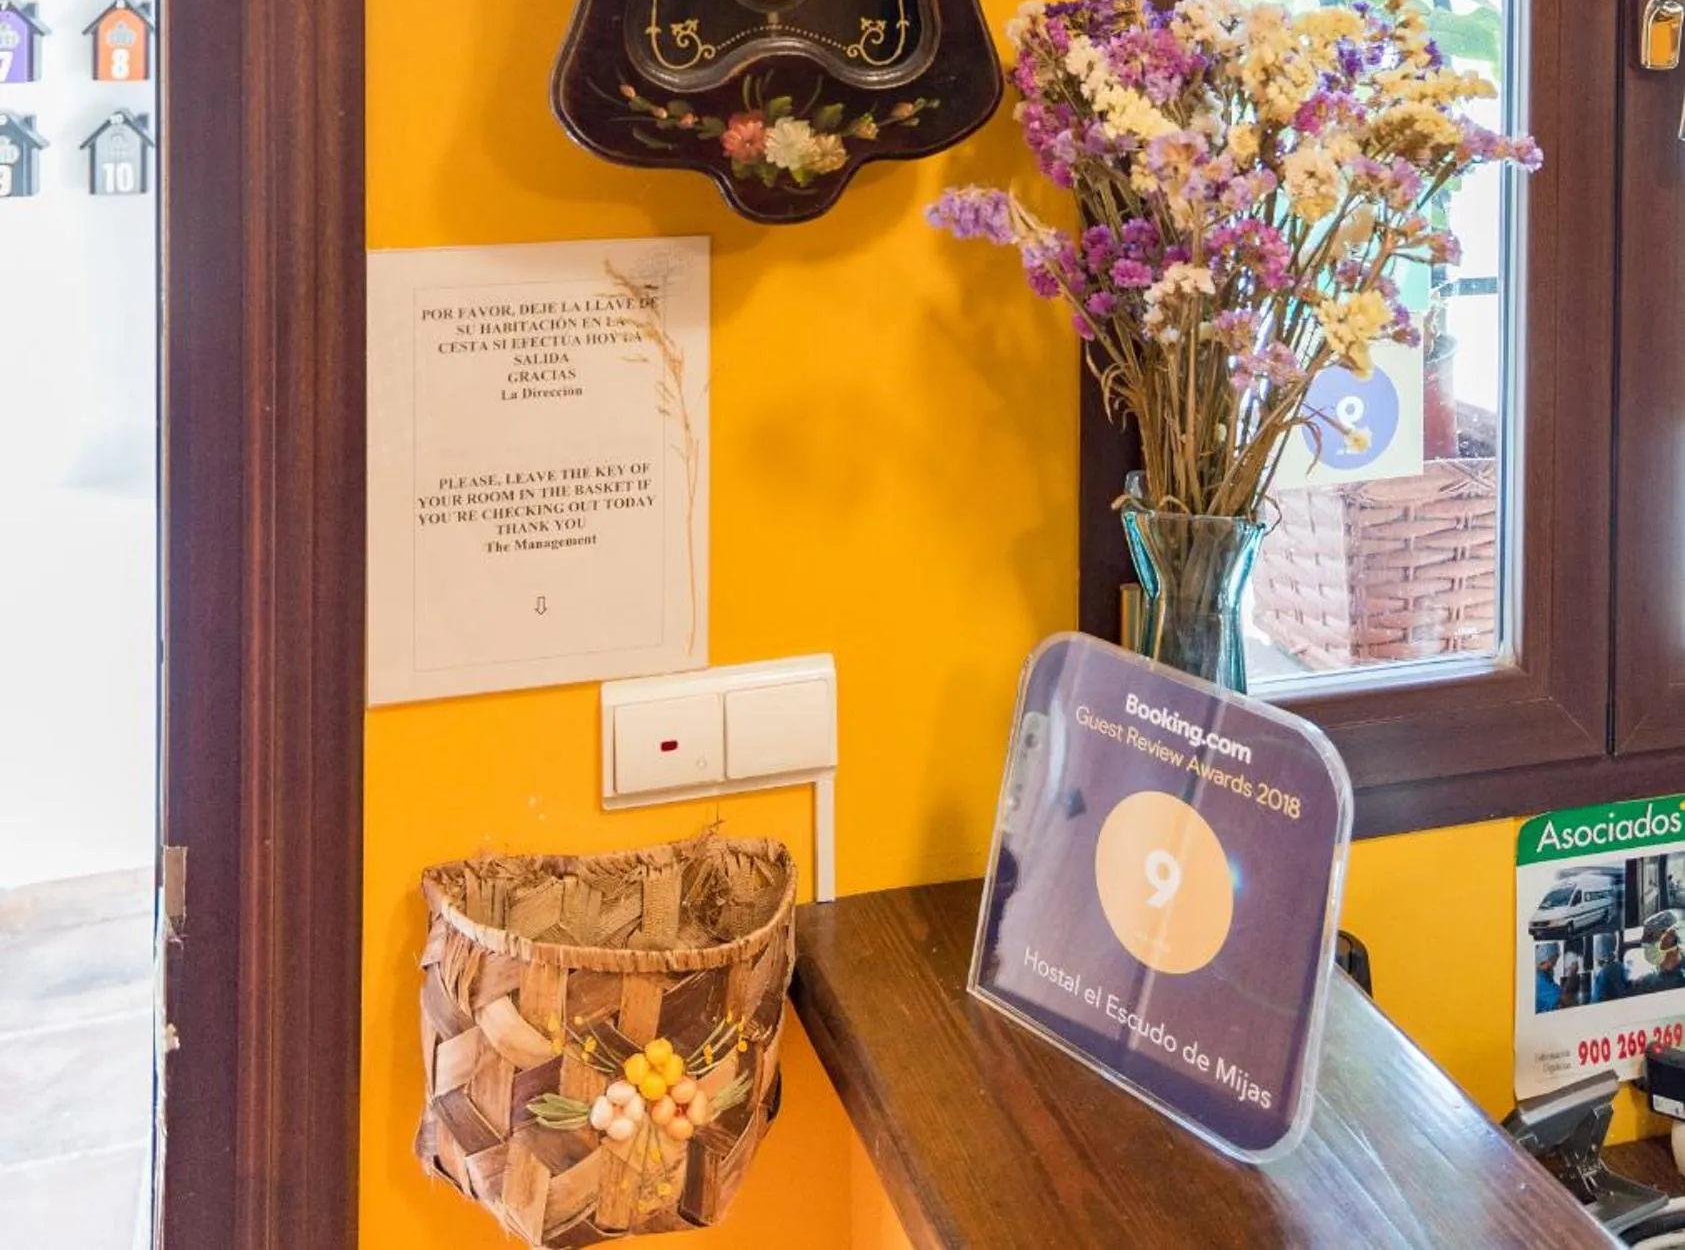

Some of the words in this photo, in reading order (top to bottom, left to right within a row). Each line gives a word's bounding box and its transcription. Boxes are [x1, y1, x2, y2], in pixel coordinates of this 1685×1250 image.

[0, 51, 14, 82] 7
[111, 48, 130, 79] 8
[103, 162, 134, 193] 10
[421, 309, 453, 320] POR
[458, 305, 515, 319] FAVOR,
[519, 302, 557, 315] DEJE
[561, 301, 581, 312] LA
[585, 298, 634, 311] LLAVE
[639, 297, 659, 309] DE
[456, 324, 475, 335] SU
[582, 317, 601, 328] EN
[606, 316, 625, 327] LA
[438, 341, 488, 353] CESTA
[492, 339, 506, 350] SI
[586, 332, 617, 344] HOY
[513, 352, 569, 365] SALIDA
[507, 368, 577, 382] GRACIAS
[501, 389, 518, 400] La
[505, 470, 557, 485] LEAVE
[561, 467, 590, 480] THE
[595, 463, 625, 477] KEY
[630, 462, 651, 474] OF
[417, 494, 463, 509] YOUR
[467, 490, 515, 505] ROOM
[519, 489, 536, 501] IN
[541, 485, 571, 498] THE
[574, 481, 634, 496] BASKET
[637, 478, 652, 490] IF
[481, 502, 565, 520] CHECKING
[568, 499, 600, 512] OUT
[603, 495, 656, 510] TODAY
[496, 520, 549, 535] THANK
[553, 517, 586, 530] YOU
[485, 540, 510, 553] The
[514, 534, 597, 551] Management
[1125, 692, 1252, 765] Booking.com
[1075, 706, 1123, 743] Guest
[1126, 725, 1185, 767] Review
[1186, 756, 1253, 799] Awards
[1255, 783, 1301, 819] 2018
[1536, 803, 1683, 853] Asociados
[1144, 850, 1181, 908] 9
[1023, 946, 1081, 997] Hostal
[1084, 985, 1102, 1009] el
[1105, 994, 1178, 1053] Escudo
[1182, 1041, 1210, 1071] de
[1215, 1056, 1273, 1110] Mijas
[1578, 1037, 1611, 1066] 900
[1616, 1029, 1648, 1060] 269
[1652, 1022, 1683, 1052] 269
